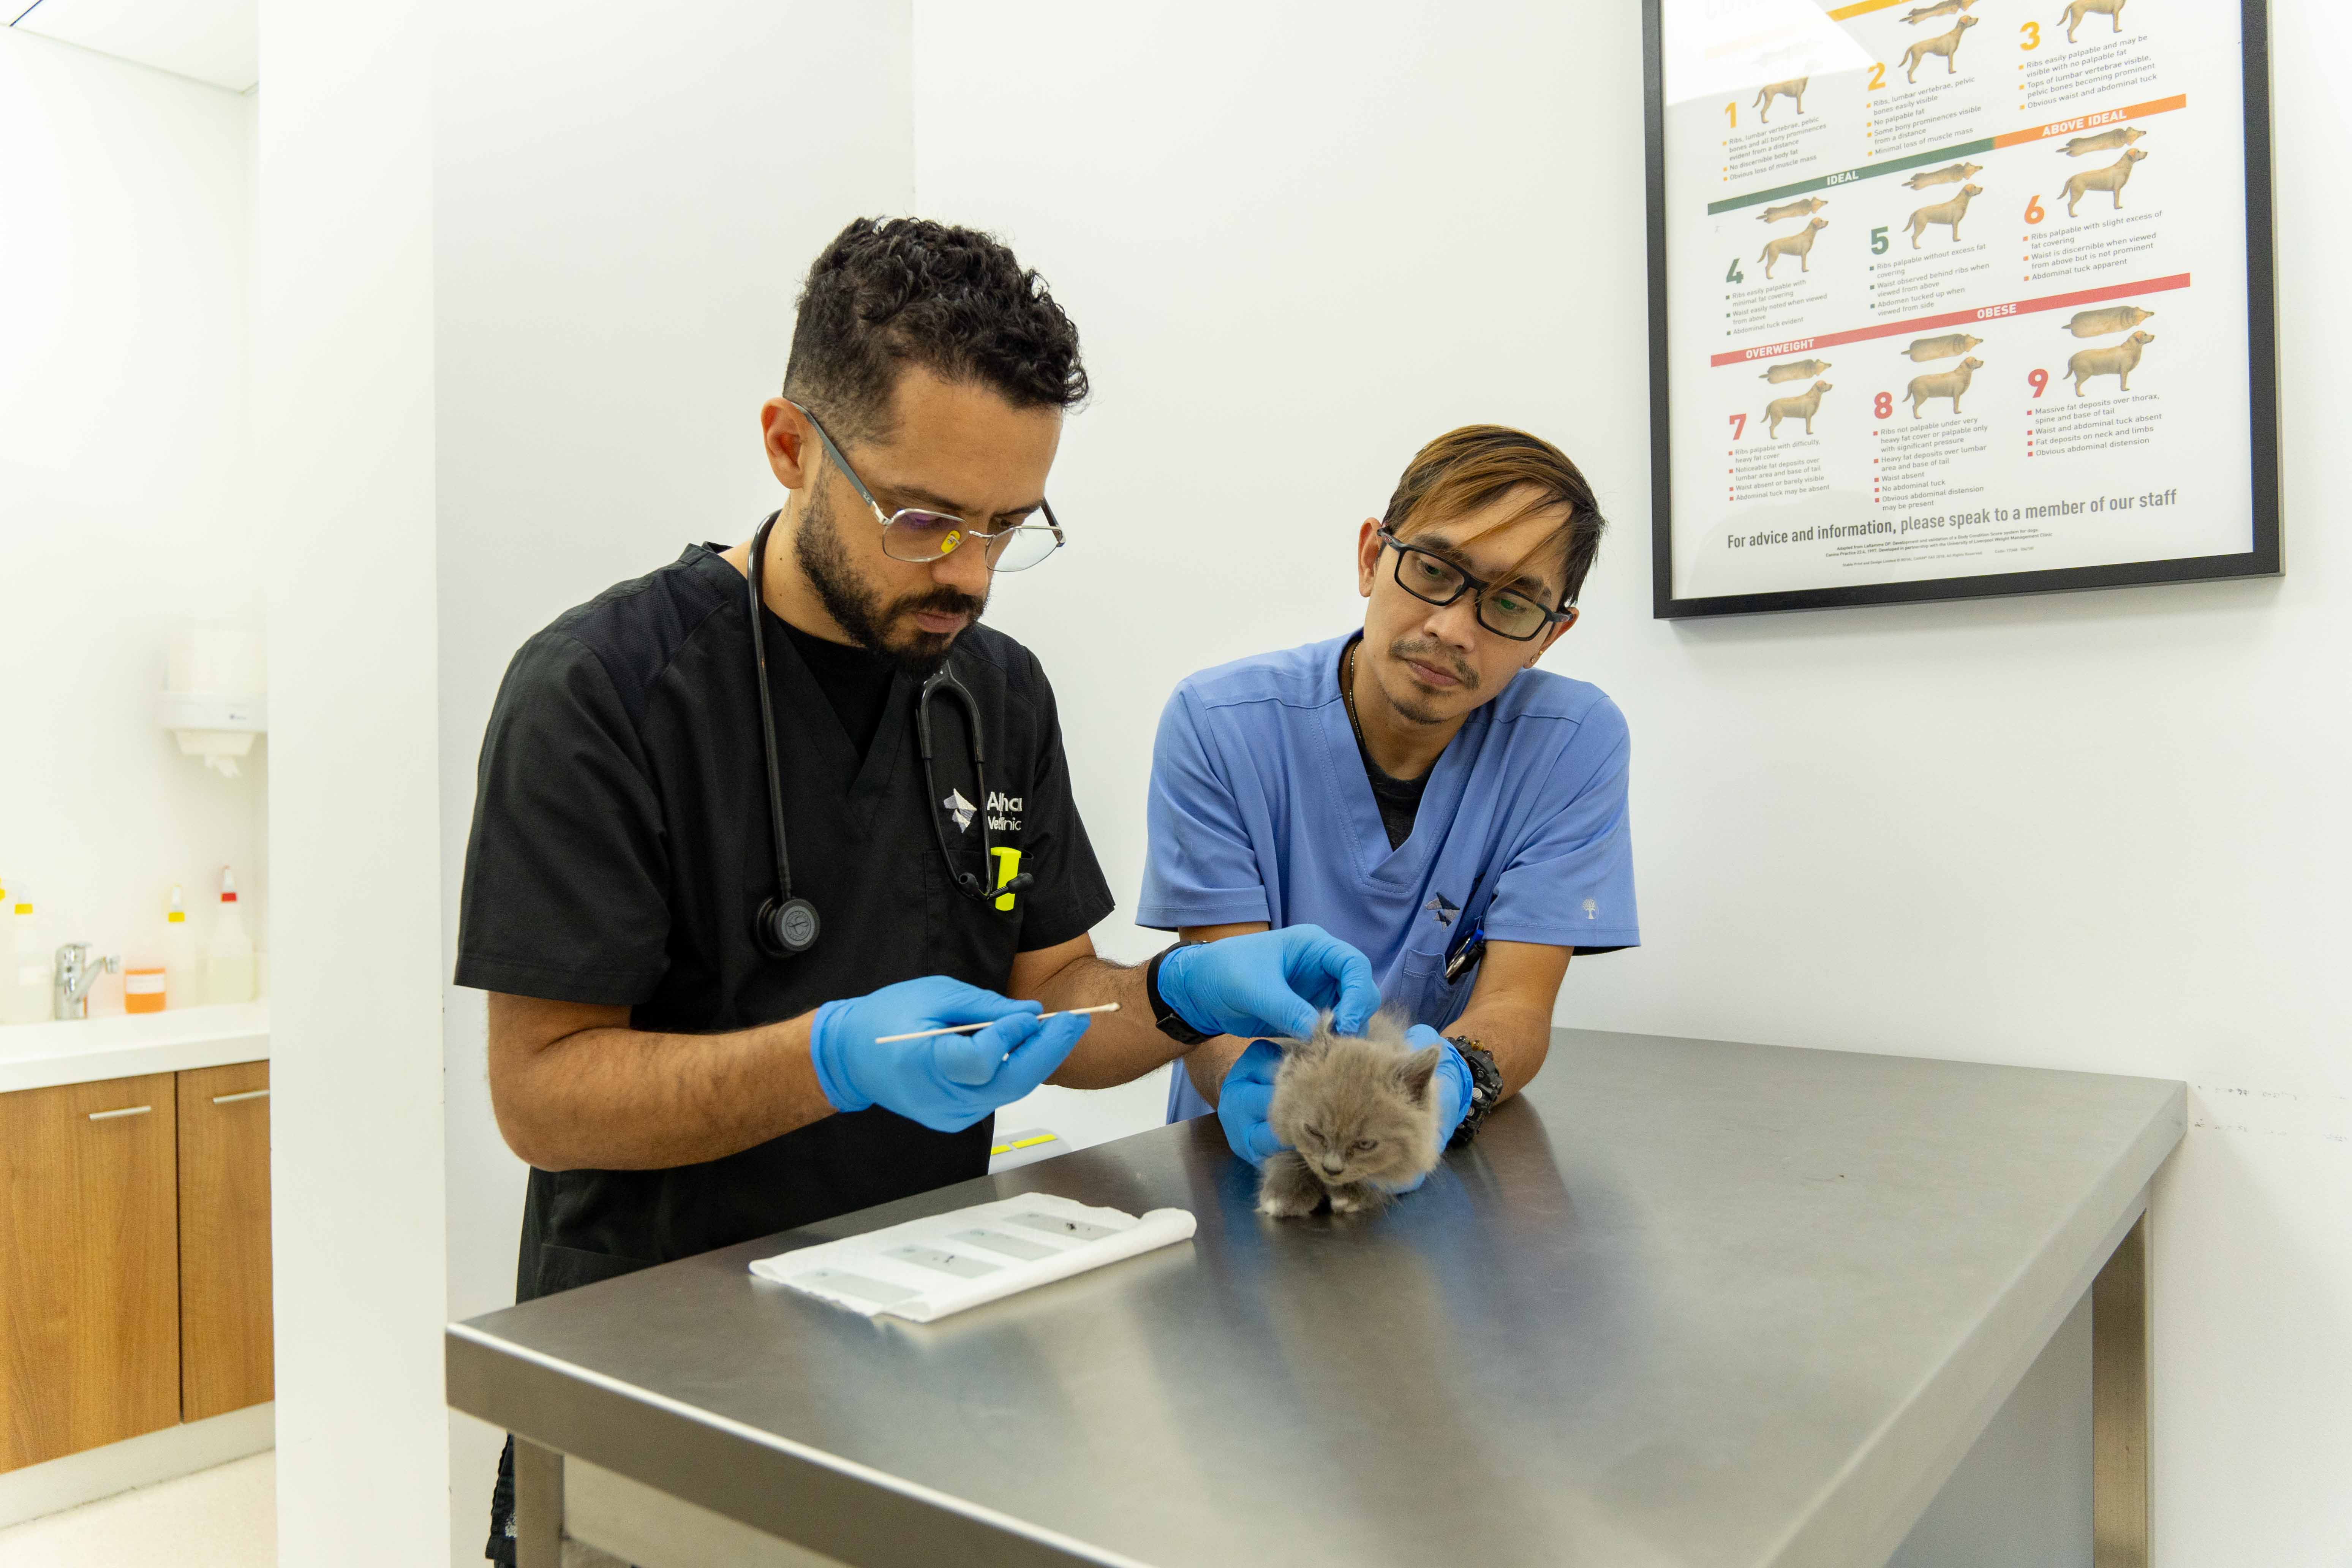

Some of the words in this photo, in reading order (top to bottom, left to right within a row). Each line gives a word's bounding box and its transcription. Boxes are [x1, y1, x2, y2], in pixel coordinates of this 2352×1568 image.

[2020, 21, 2040, 51] 3
[2045, 55, 2066, 64] easily
[2068, 46, 2101, 60] palpable
[2103, 41, 2117, 50] and
[2026, 68, 2050, 77] visible
[2052, 63, 2067, 71] with
[2081, 52, 2114, 66] palpable
[2055, 72, 2082, 82] lumbar
[2085, 62, 2121, 74] vertebrae
[1867, 62, 1886, 91] 2
[2027, 89, 2048, 99] pelvic
[2050, 83, 2073, 92] bones
[2075, 74, 2112, 86] becoming
[2115, 62, 2154, 78] prominent
[1891, 92, 1916, 102] lumbar
[1955, 77, 1974, 87] pelvic
[2027, 98, 2057, 108] Obvious
[2058, 92, 2078, 101] waist
[2080, 88, 2095, 96] and
[2097, 78, 2137, 92] abdominal
[2140, 73, 2156, 82] tuck
[1725, 102, 1736, 128] 1
[2042, 119, 2084, 136] ABOVE
[2088, 110, 2127, 126] IDEAL
[1827, 171, 1859, 186] IDEAL
[2024, 194, 2044, 224] 6
[2049, 226, 2081, 238] palpable
[2102, 218, 2123, 227] slight
[2126, 213, 2152, 222] excess
[1871, 226, 1889, 255] 5
[2031, 251, 2051, 259] Waist
[2062, 242, 2104, 254] discernible
[2129, 232, 2156, 242] viewed
[2043, 238, 2074, 247] covering
[2113, 242, 2153, 256] prominent
[1893, 257, 1922, 267] palpable
[1923, 251, 1949, 260] without
[2032, 268, 2071, 280] Abdominal
[2093, 258, 2127, 270] apparent
[1726, 258, 1744, 284] 4
[1877, 269, 1905, 278] covering
[1897, 274, 1928, 285] observed
[1929, 269, 1953, 278] behind
[1977, 303, 2016, 319] OBESE
[1746, 339, 1815, 359] OVERWEIGHT
[2028, 369, 2048, 398] 9
[1874, 392, 1892, 419] 8
[2079, 400, 2111, 409] deposits
[1729, 413, 1747, 441] 7
[1909, 423, 1939, 432] palpable
[2074, 419, 2113, 430] abdominal
[2135, 413, 2161, 422] absent
[1897, 441, 1932, 451] significant
[1934, 438, 1964, 447] pressure
[2049, 435, 2081, 444] deposits
[2067, 442, 2107, 452] abdominal
[2109, 438, 2149, 447] distension
[1893, 481, 1928, 490] abdominal
[1910, 490, 1946, 499] abdominal
[1908, 500, 1934, 509] present
[1728, 535, 1744, 548] For
[1749, 531, 1788, 546] advice
[1792, 527, 1813, 541] and
[1818, 521, 1896, 539] information,
[1900, 517, 1944, 533] please
[1949, 509, 1990, 528] speak
[1995, 508, 2008, 521] to
[2012, 509, 2020, 519] a
[2025, 501, 2085, 518] member
[2090, 498, 2104, 511] of
[2109, 498, 2134, 509] our
[2139, 491, 2176, 506] staff
